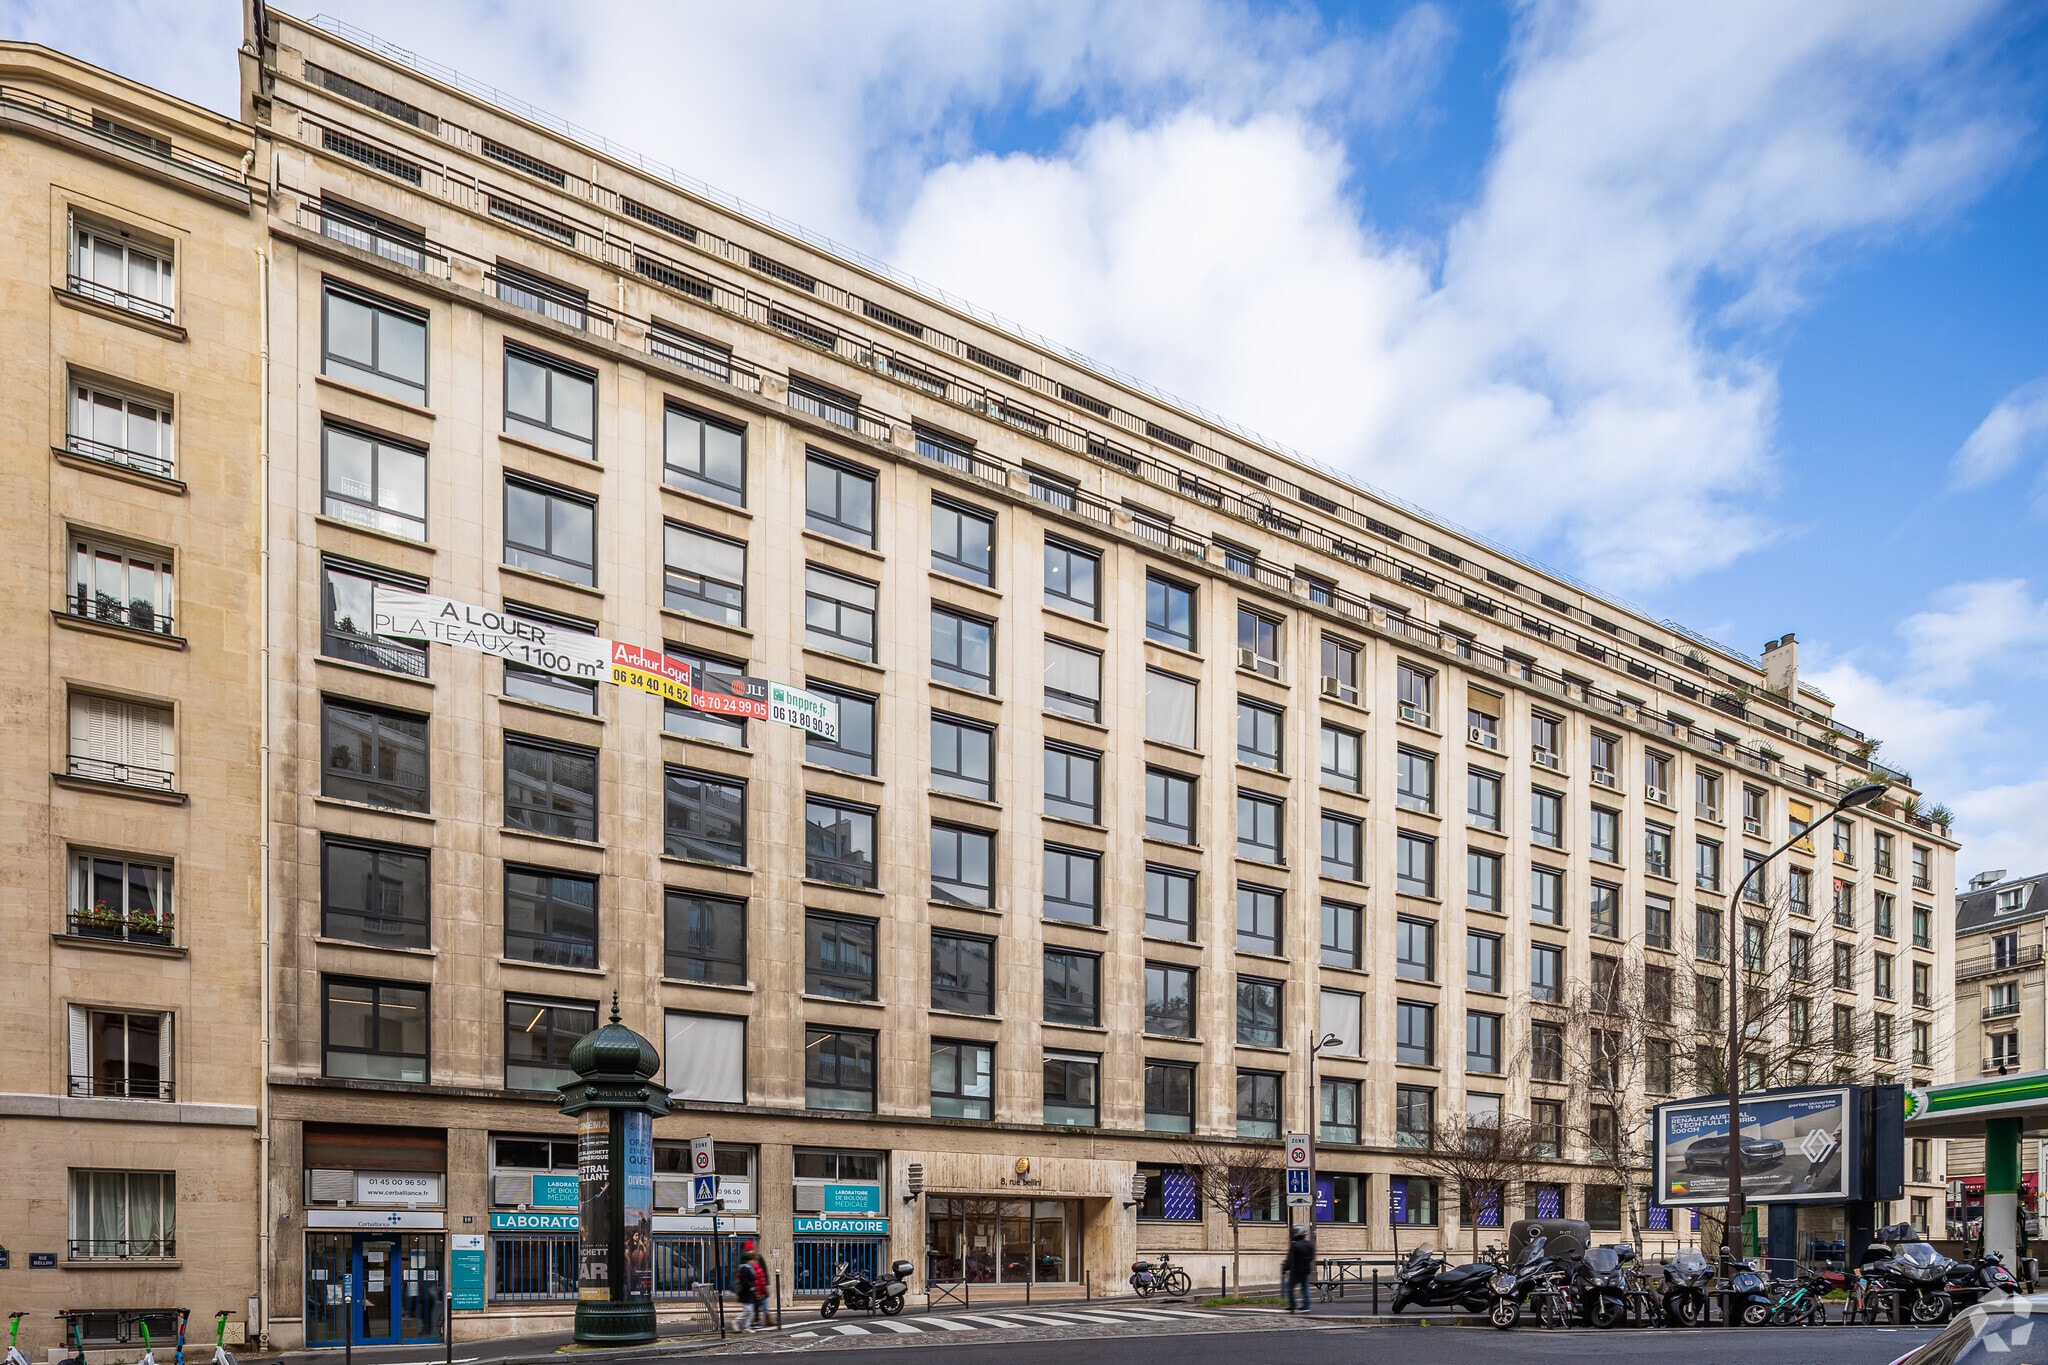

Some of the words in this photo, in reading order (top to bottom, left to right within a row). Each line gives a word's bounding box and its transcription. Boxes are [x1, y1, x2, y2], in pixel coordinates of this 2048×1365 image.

[440, 602, 459, 621] A
[466, 607, 545, 645] LOUER
[375, 613, 514, 657] PLATEAUX
[520, 645, 571, 672] 1100
[577, 659, 604, 677] m²
[614, 643, 660, 672] Arthur
[661, 653, 689, 683] Loyd
[613, 669, 627, 683] 06
[630, 673, 643, 687] 34
[646, 677, 659, 692] 40
[662, 682, 674, 697] 14
[676, 687, 689, 703] 52
[745, 683, 764, 697] JLL
[693, 693, 705, 708] 06
[708, 697, 721, 710] 70
[723, 698, 736, 712] 24
[738, 701, 752, 714] 99
[753, 702, 767, 716] 05
[786, 690, 827, 718] bnppre.fr
[773, 705, 785, 720] 06
[787, 709, 798, 724] 13
[799, 713, 811, 728] 80
[812, 717, 823, 733] 90
[824, 722, 835, 738] 32
[1671, 1115, 1708, 1124] RENAULT
[1709, 1111, 1749, 1121] AUSTAL
[1671, 1121, 1701, 1129] E-TECH
[1702, 1119, 1723, 1127] FULL
[1724, 1116, 1757, 1125] HRID
[699, 1156, 707, 1165] 30
[1294, 1151, 1303, 1159] 30
[1022, 1178, 1042, 1187] bellini
[547, 1193, 579, 1201] MÉDICA
[496, 1215, 579, 1228] LABORATO
[798, 1220, 883, 1231] LABORATOIRE
